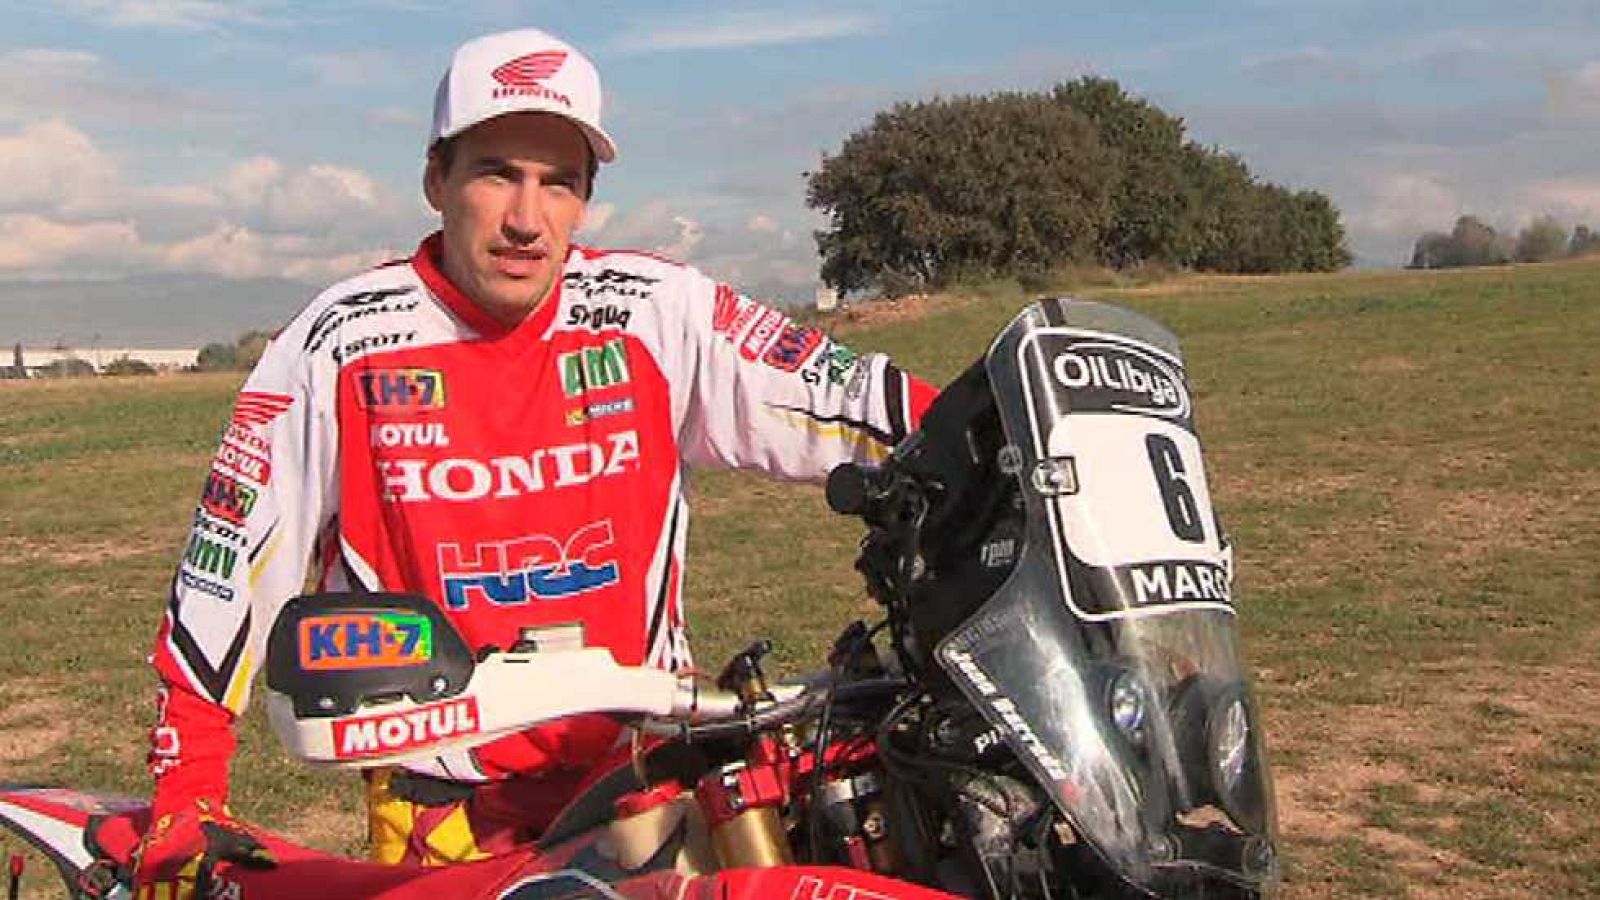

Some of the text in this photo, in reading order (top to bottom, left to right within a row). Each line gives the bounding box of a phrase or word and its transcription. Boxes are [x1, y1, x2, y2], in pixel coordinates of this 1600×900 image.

[492, 87, 572, 108] HONDA
[370, 423, 450, 447] OTUL
[377, 430, 640, 503] HONDA
[1145, 432, 1204, 542] 6
[436, 519, 620, 609] HRC
[342, 703, 475, 754] MOTUL
